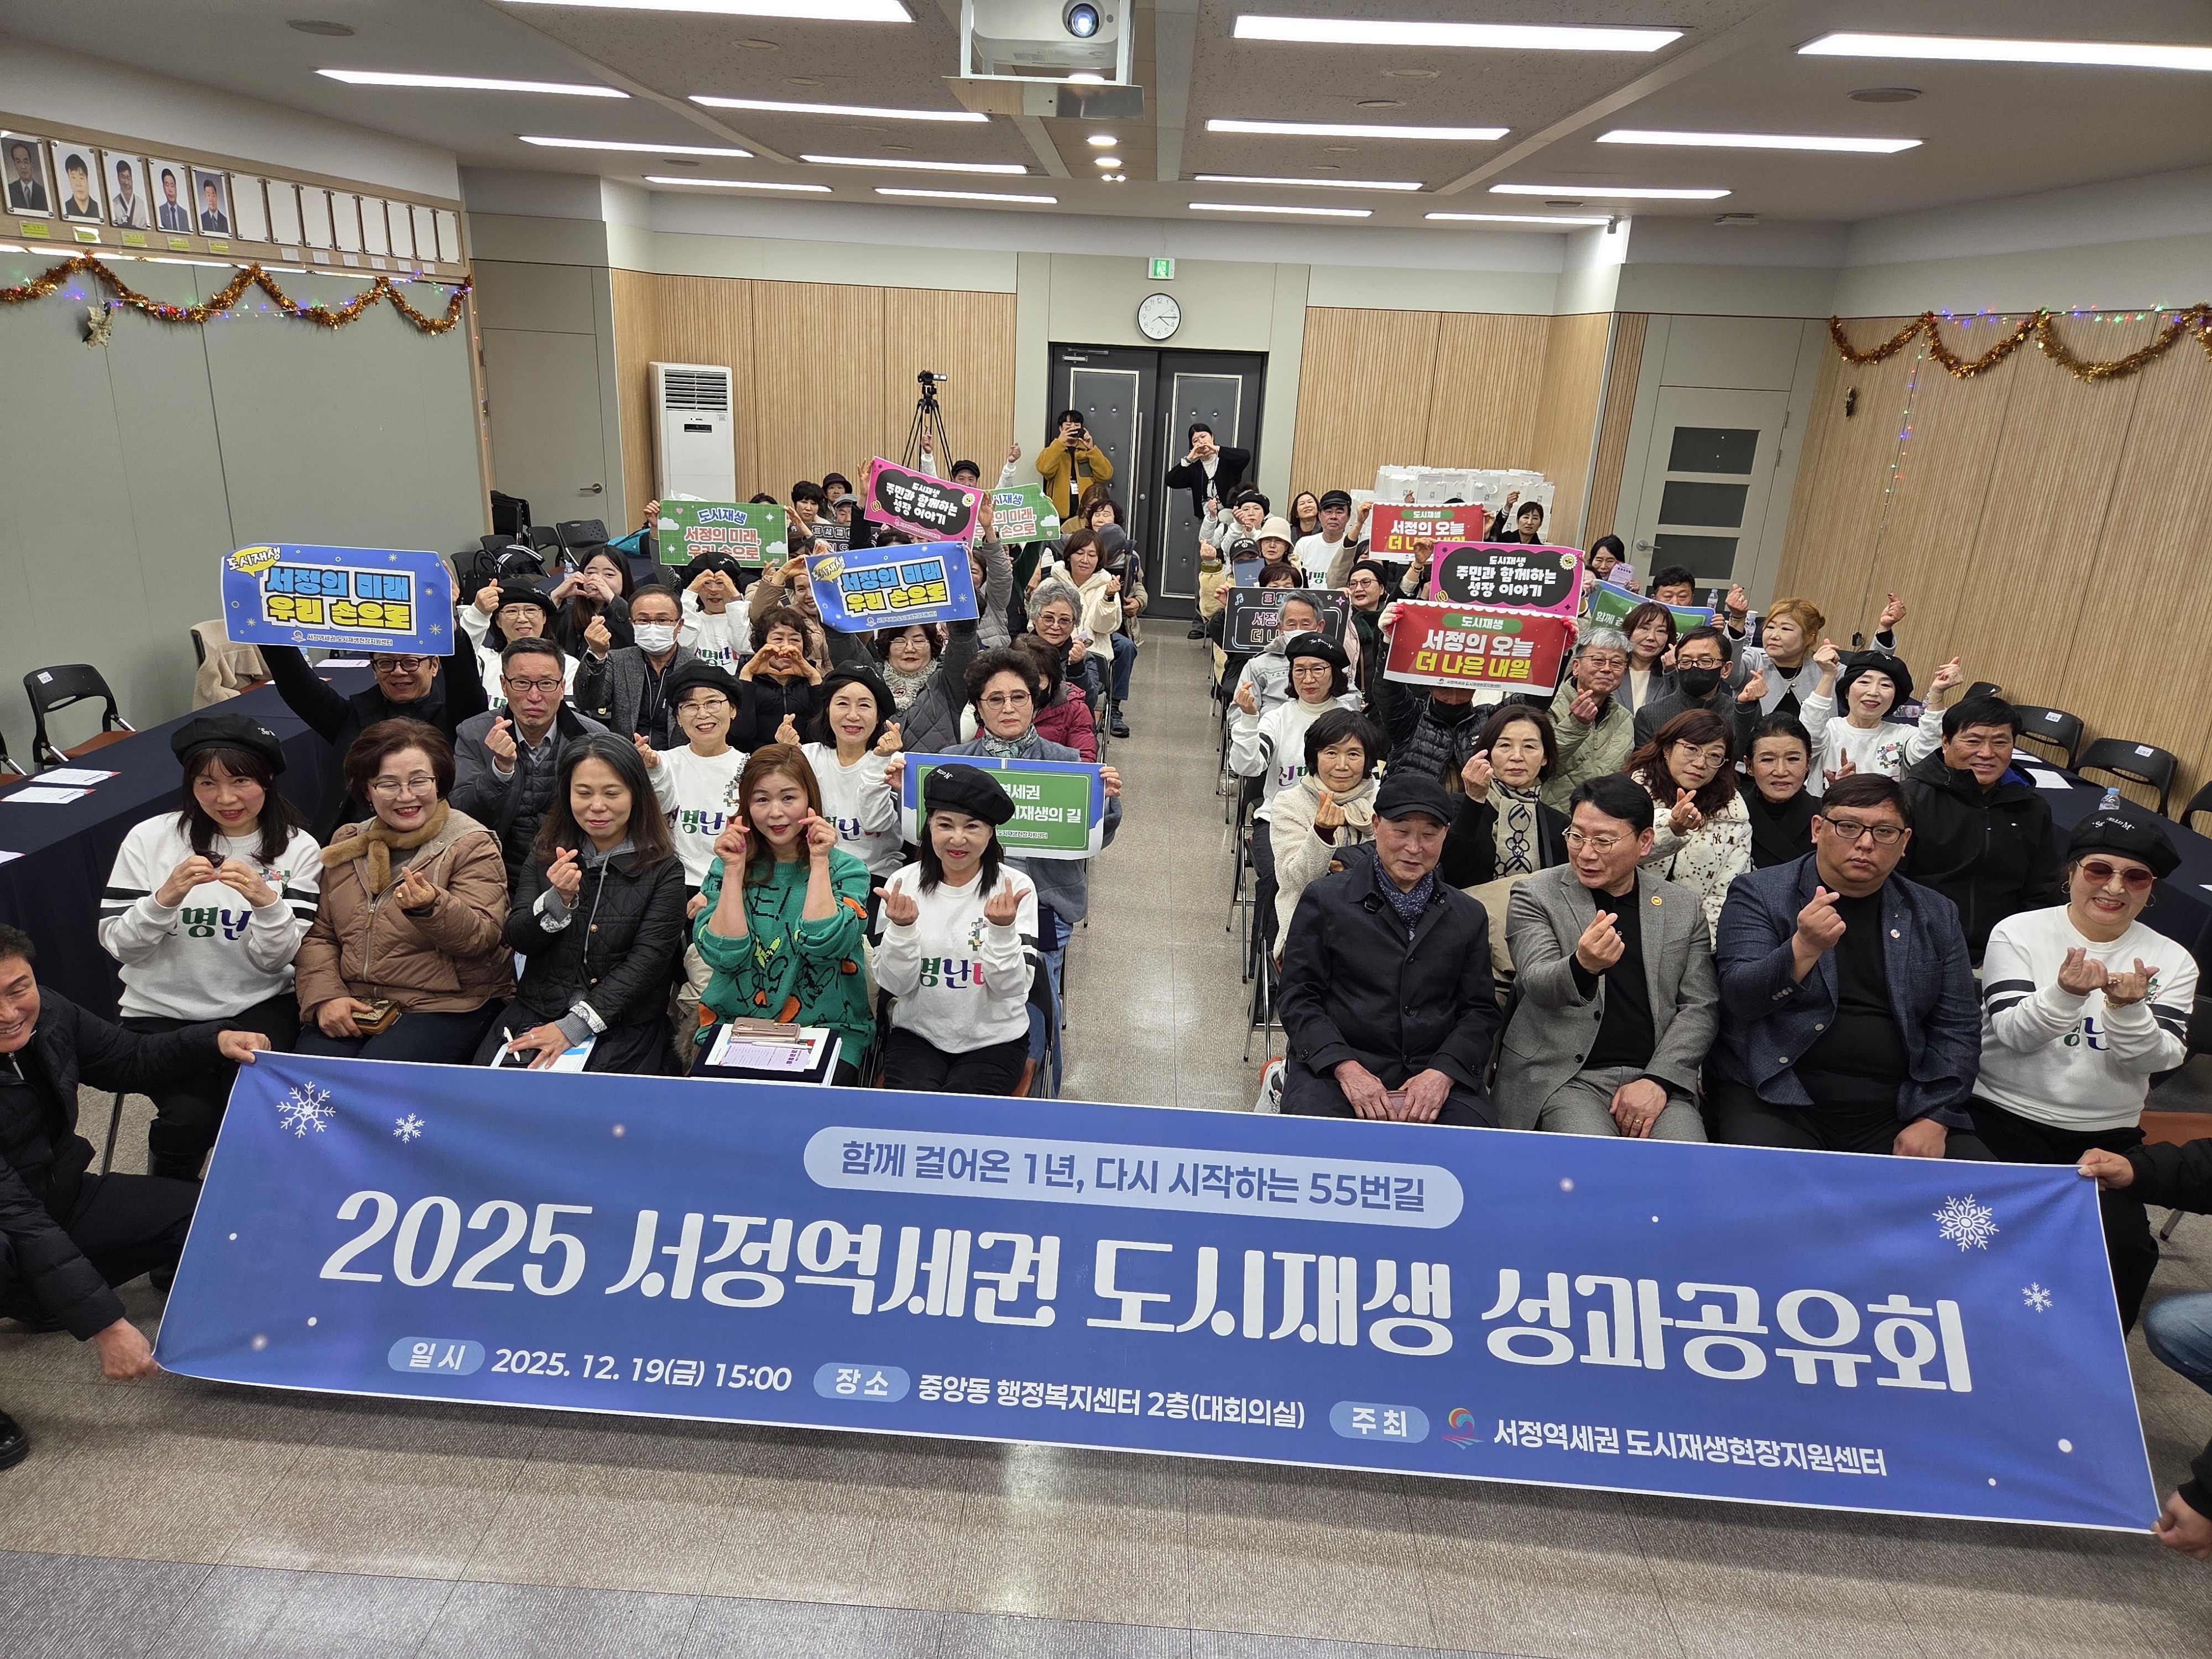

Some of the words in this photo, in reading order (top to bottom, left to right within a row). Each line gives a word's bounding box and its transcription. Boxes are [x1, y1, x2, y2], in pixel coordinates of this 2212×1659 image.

[912, 482, 940, 498] 도시재생
[886, 482, 915, 501] 주민과
[917, 494, 958, 517] 함께하는
[993, 494, 1023, 505] 시재생
[698, 508, 747, 525] 도시재생
[893, 499, 911, 516] 성장
[914, 507, 946, 525] 이야기
[1009, 508, 1036, 523] 미래,
[685, 527, 726, 542] 서정의
[729, 529, 761, 545] 미래,
[1001, 523, 1036, 538] 손으로
[1391, 520, 1432, 535] 서정의
[1436, 521, 1464, 535] 오늘
[1389, 536, 1402, 550] 더
[227, 546, 281, 568] 도시재생
[1489, 556, 1526, 567] 도시재생
[811, 555, 845, 581] 도시재생
[842, 567, 900, 592] 서정의
[900, 560, 943, 585] 미래
[1457, 566, 1495, 581] 주민과
[1500, 567, 1556, 585] 함께하는
[265, 566, 349, 598] 서정의
[356, 571, 410, 602] 미래
[1468, 582, 1495, 597] 성장
[1499, 584, 1542, 597] 이야기
[846, 591, 887, 613] 우리
[888, 582, 947, 608] 손으로
[267, 596, 324, 624] 우리
[331, 600, 412, 630] 손으로
[1251, 612, 1278, 627] 서정
[1595, 611, 1615, 625] 함께
[1462, 617, 1504, 630] 도시재생
[1251, 628, 1264, 643] 더
[1422, 629, 1488, 654] 서정의
[1490, 637, 1534, 657] 오늘
[1416, 651, 1437, 671] 더
[1442, 654, 1484, 676] 나은
[1488, 658, 1531, 679] 내일
[1067, 808, 1081, 823] 길
[843, 1141, 905, 1177] 함께
[915, 1146, 1010, 1183] 걸어온
[1025, 1153, 1084, 1193] 1년,
[1096, 1157, 1159, 1194] 다시
[1169, 1163, 1299, 1203] 시작하는
[1309, 1172, 1425, 1212] 55번길
[320, 1191, 592, 1295] 2025
[605, 1209, 1060, 1327] 서정역세권
[1087, 1239, 1452, 1356] 도시재생
[1482, 1269, 1972, 1392] 성과공유회
[491, 1349, 570, 1376] 2025.
[583, 1355, 619, 1380] 12.
[632, 1358, 705, 1387] 19(금)
[716, 1363, 792, 1391] 15:00
[919, 1374, 990, 1404] 중앙동
[997, 1380, 1140, 1416] 행정복지센터
[1147, 1392, 1305, 1429] 2층(대회의실)
[1494, 1420, 1619, 1454] 서정역세권
[1626, 1430, 1887, 1476] 도시재생현장지원센터
